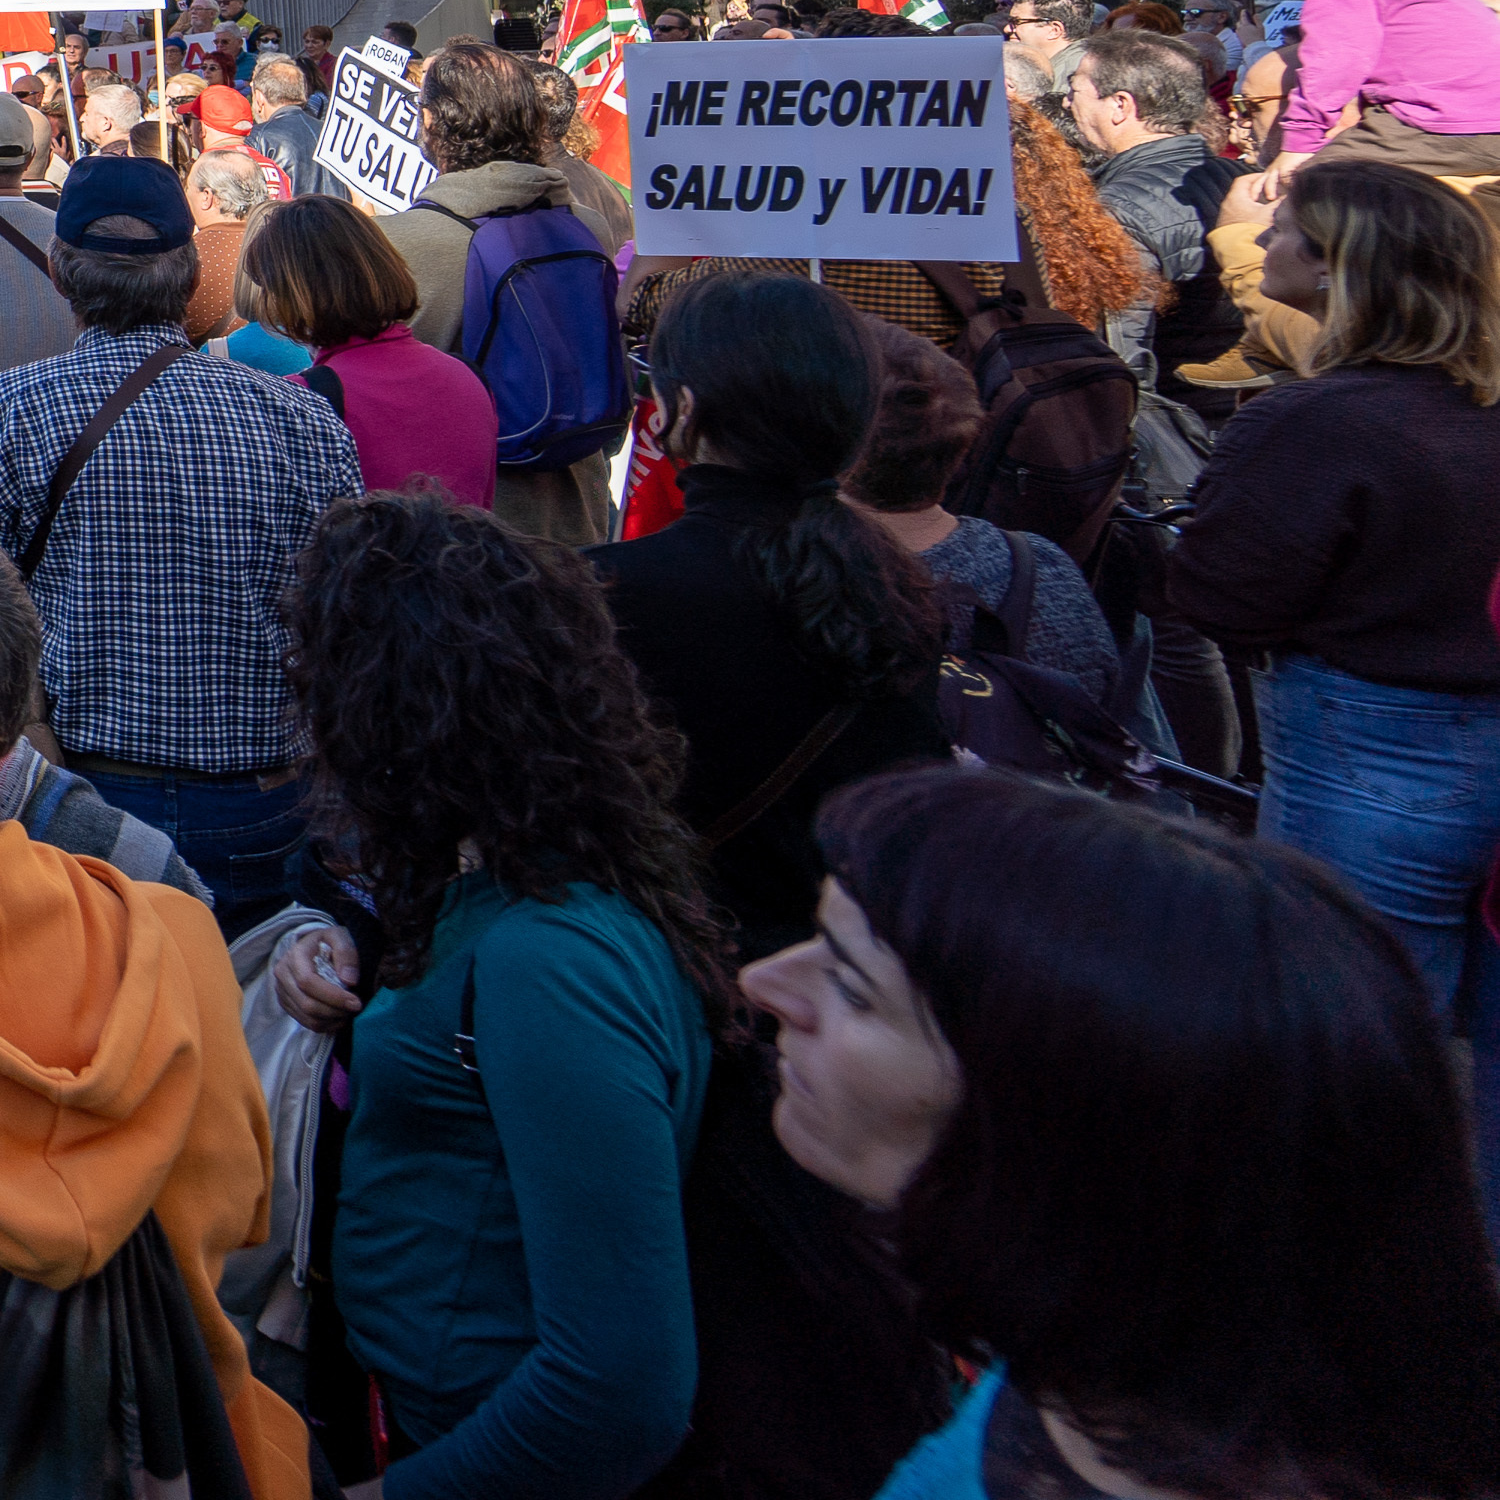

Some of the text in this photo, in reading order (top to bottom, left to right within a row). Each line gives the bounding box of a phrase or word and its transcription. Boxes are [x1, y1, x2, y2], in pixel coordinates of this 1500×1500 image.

[338, 63, 378, 111] SE
[644, 78, 992, 138] ¡ME RECORTAN
[329, 107, 364, 164] TU
[357, 131, 439, 205] SALU
[644, 163, 995, 226] SALUD y VIDA!
